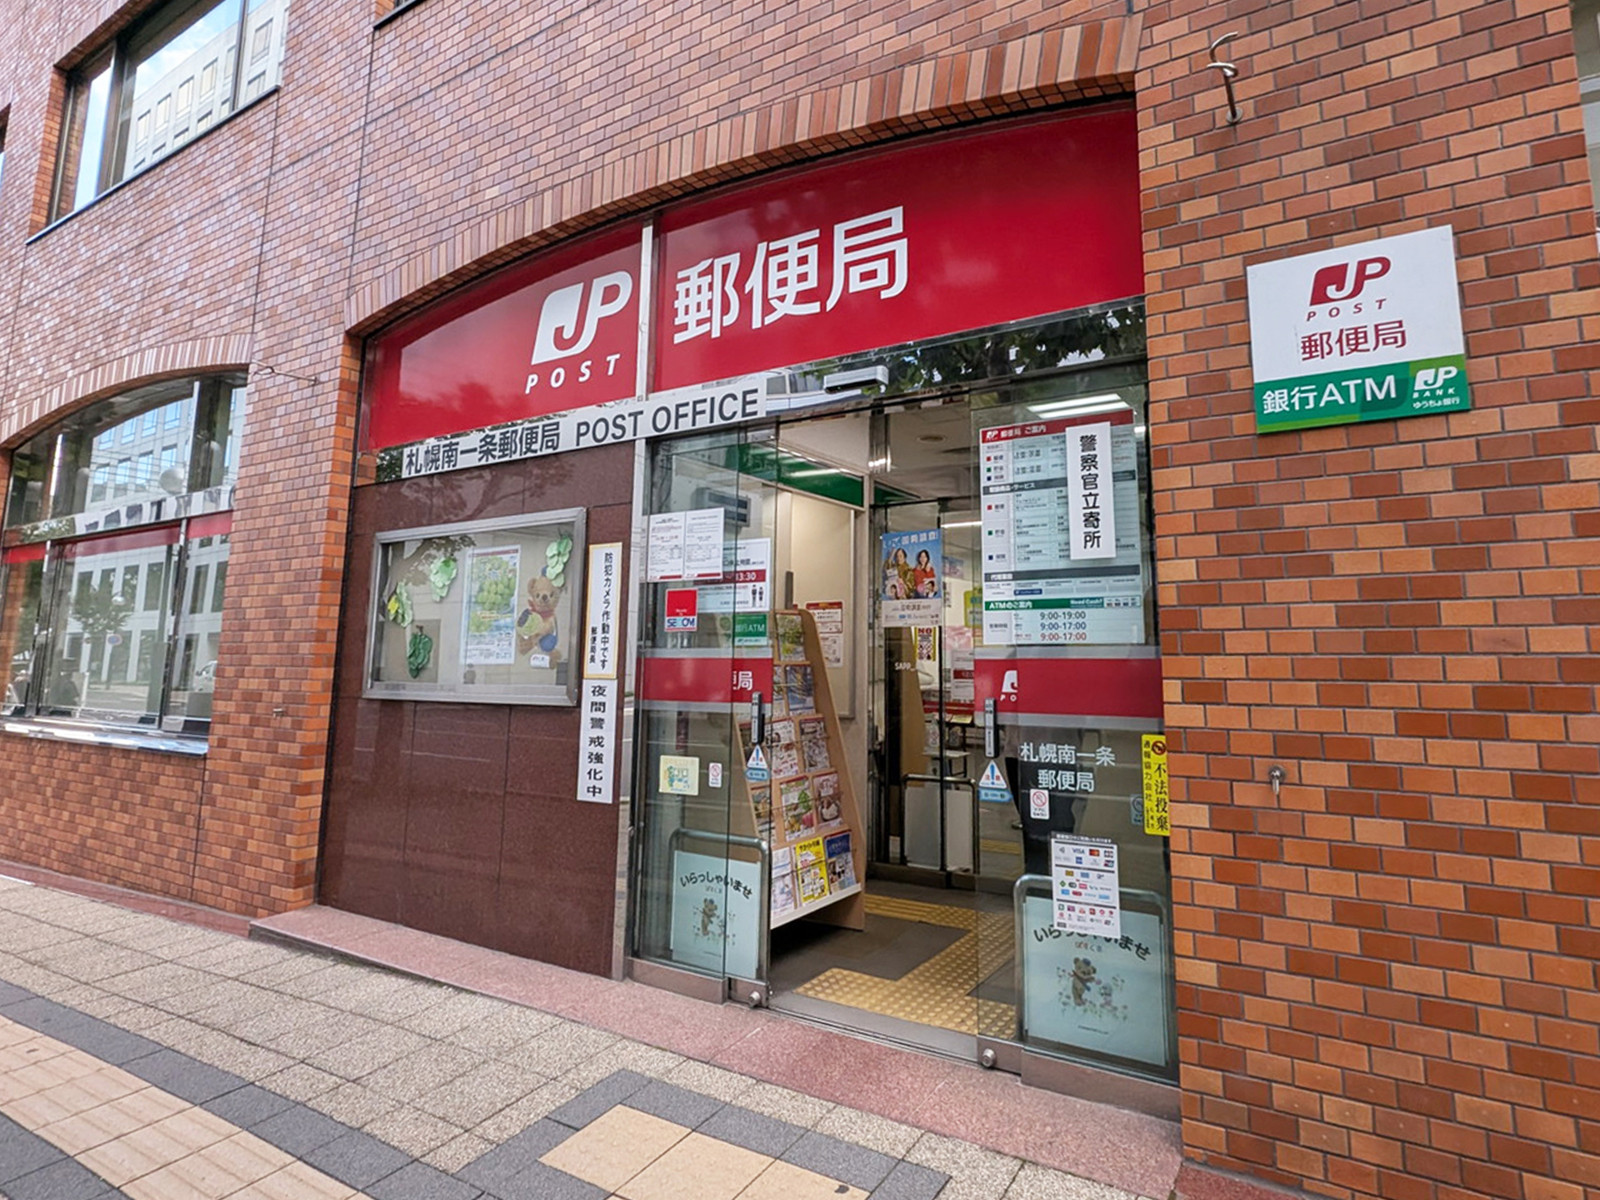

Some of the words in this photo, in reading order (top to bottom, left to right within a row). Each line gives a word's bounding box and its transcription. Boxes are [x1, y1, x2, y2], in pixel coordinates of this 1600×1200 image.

[673, 205, 908, 345] 郵便局
[1309, 256, 1391, 307] JP
[531, 270, 633, 366] JP
[1306, 298, 1387, 322] POST
[1300, 320, 1407, 361] 郵便局
[525, 353, 621, 395] POST
[1262, 374, 1397, 414] 銀行ATM
[1412, 387, 1456, 399] BANK
[1414, 366, 1458, 391] JP
[405, 421, 561, 476] 札幌南一条郵便局
[575, 410, 643, 447] POST
[652, 388, 759, 434] OFFICE
[1079, 434, 1101, 549] 警察官立寄所
[600, 552, 613, 670] 防犯カメラ作動中です
[1040, 611, 1086, 620] 9:00-19:00
[1040, 621, 1087, 630] 9:00-17:00
[1040, 631, 1087, 641] 9:00-17:00
[586, 685, 608, 797] 夜間警戒強化中
[1020, 742, 1116, 767] 札幌南一条
[1037, 769, 1095, 792] 郵便局
[1154, 763, 1169, 832] 不法投棄
[680, 871, 753, 900] いらっしゃいませ
